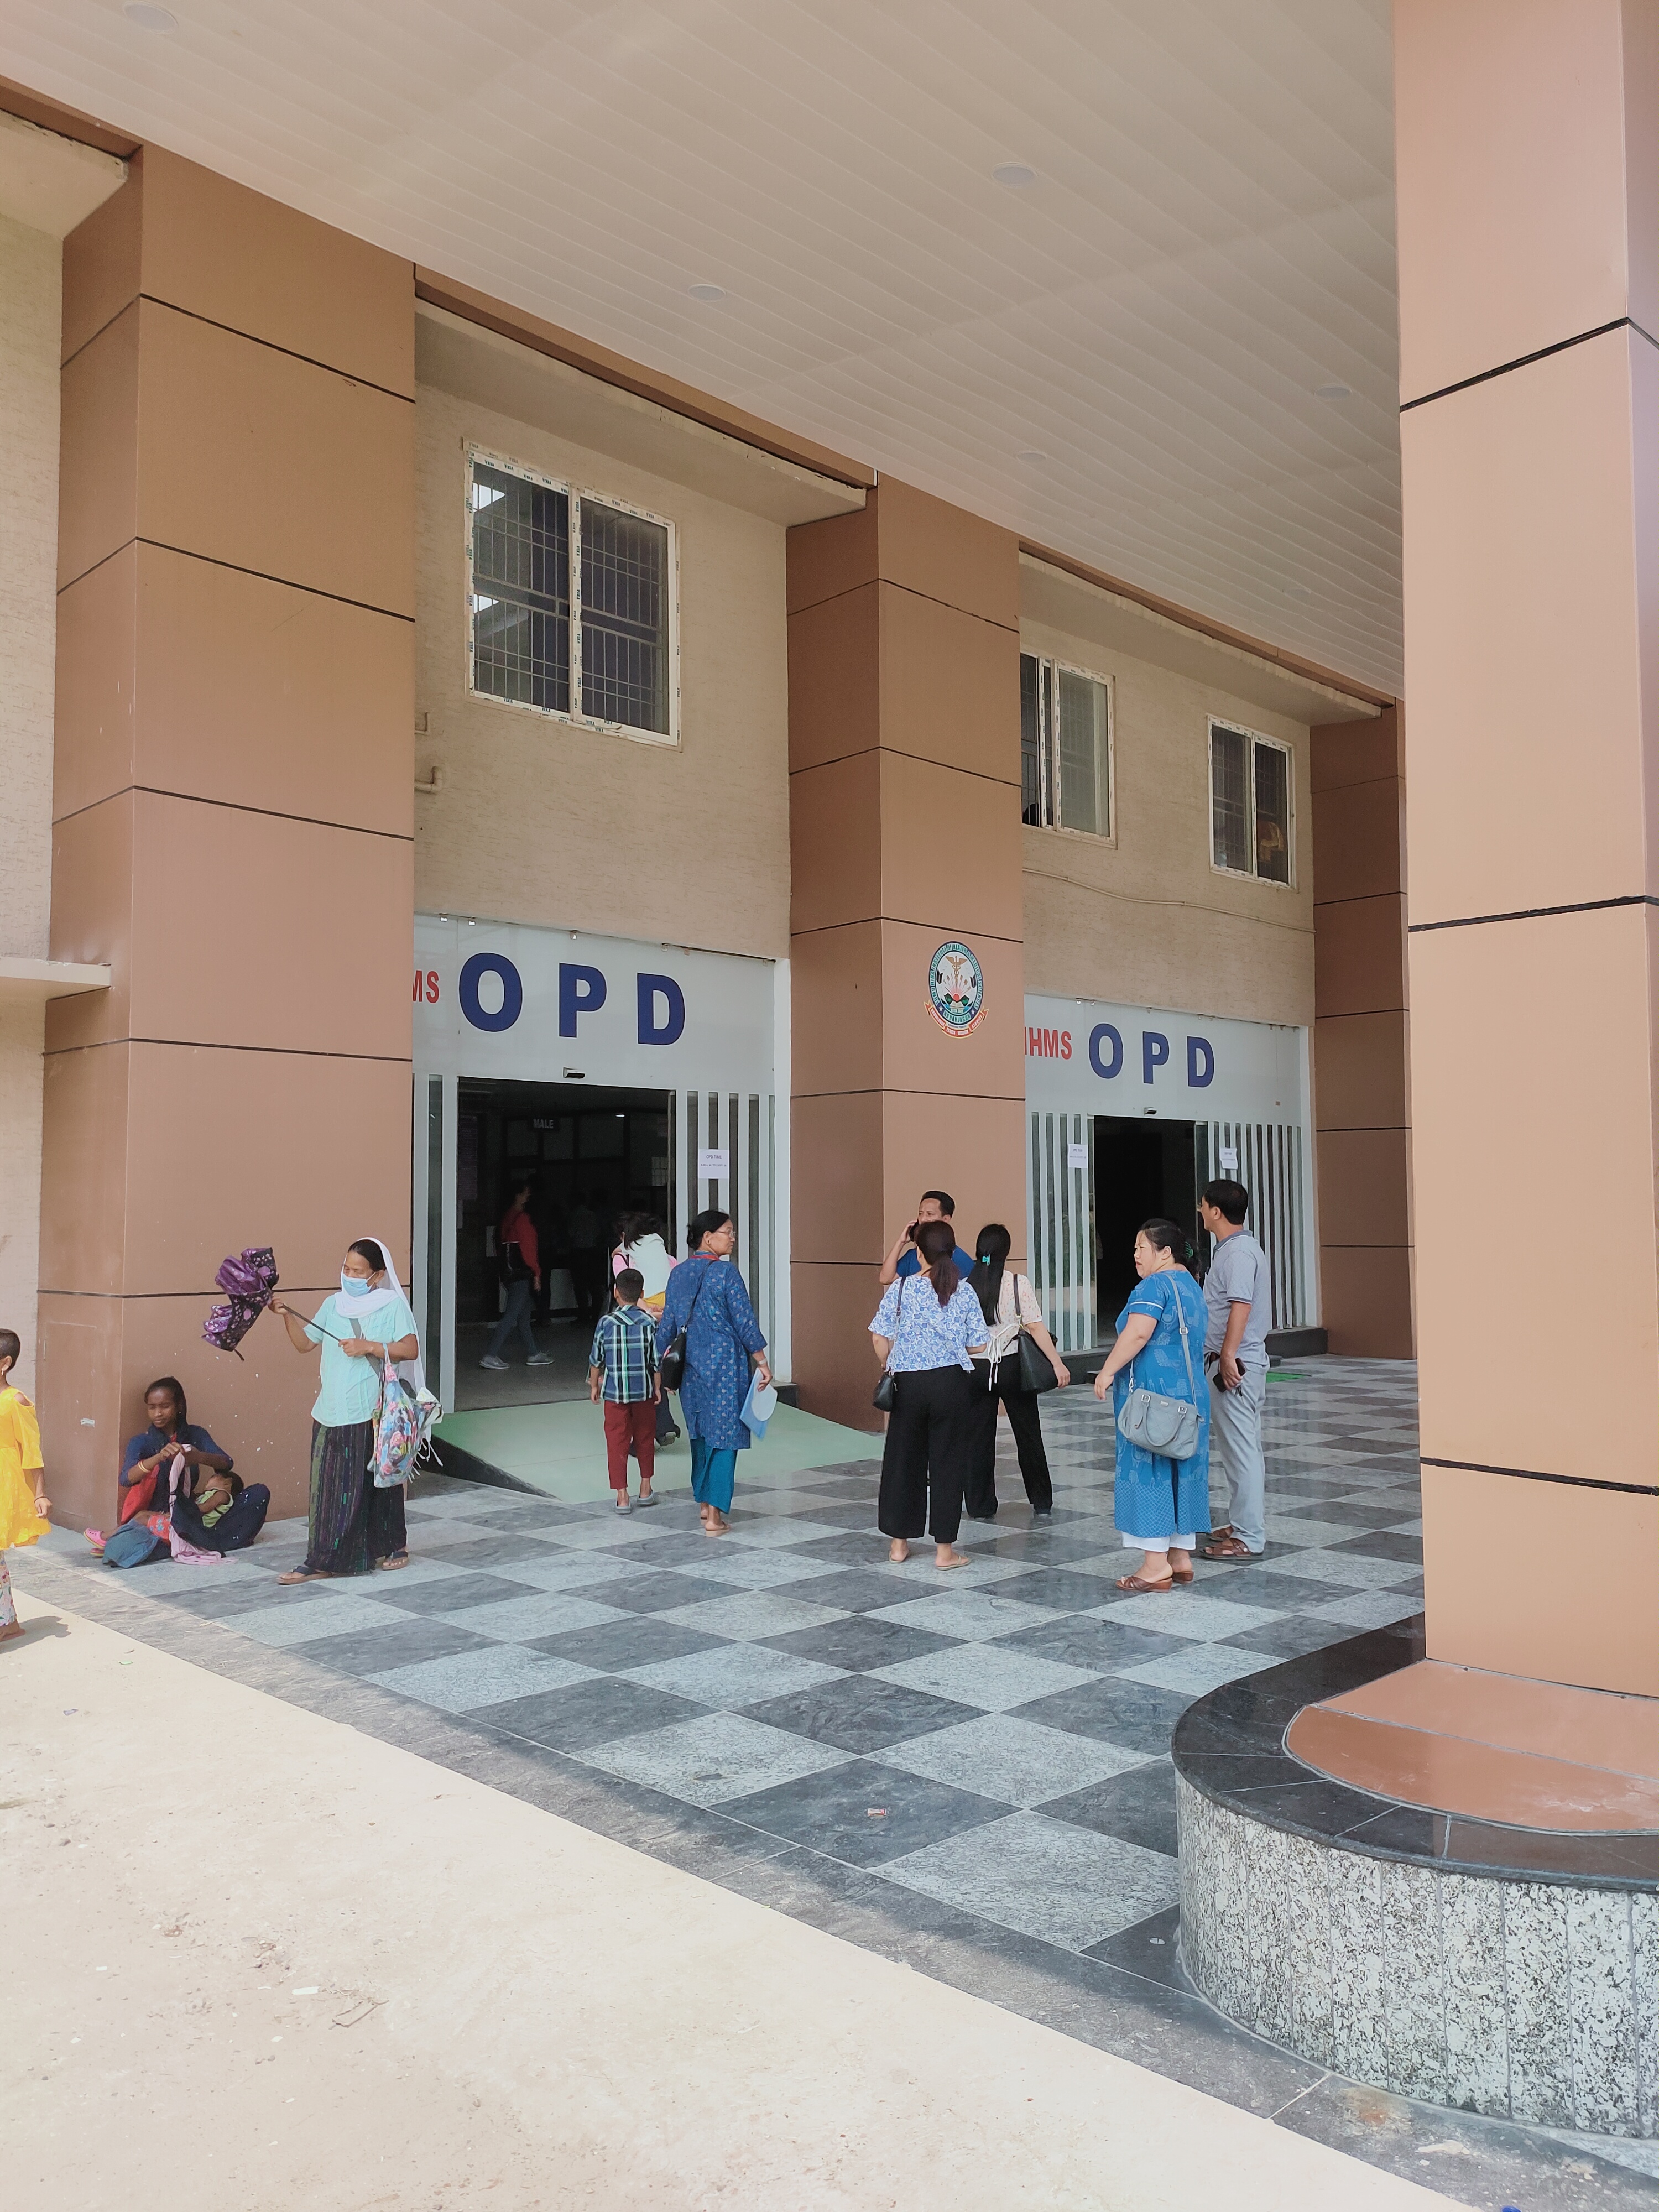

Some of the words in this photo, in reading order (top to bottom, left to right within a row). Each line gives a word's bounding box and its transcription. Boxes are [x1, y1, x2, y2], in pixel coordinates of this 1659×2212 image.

[459, 952, 685, 1045] OPD
[1088, 1023, 1214, 1088] OPD
[533, 1118, 554, 1129] MALE
